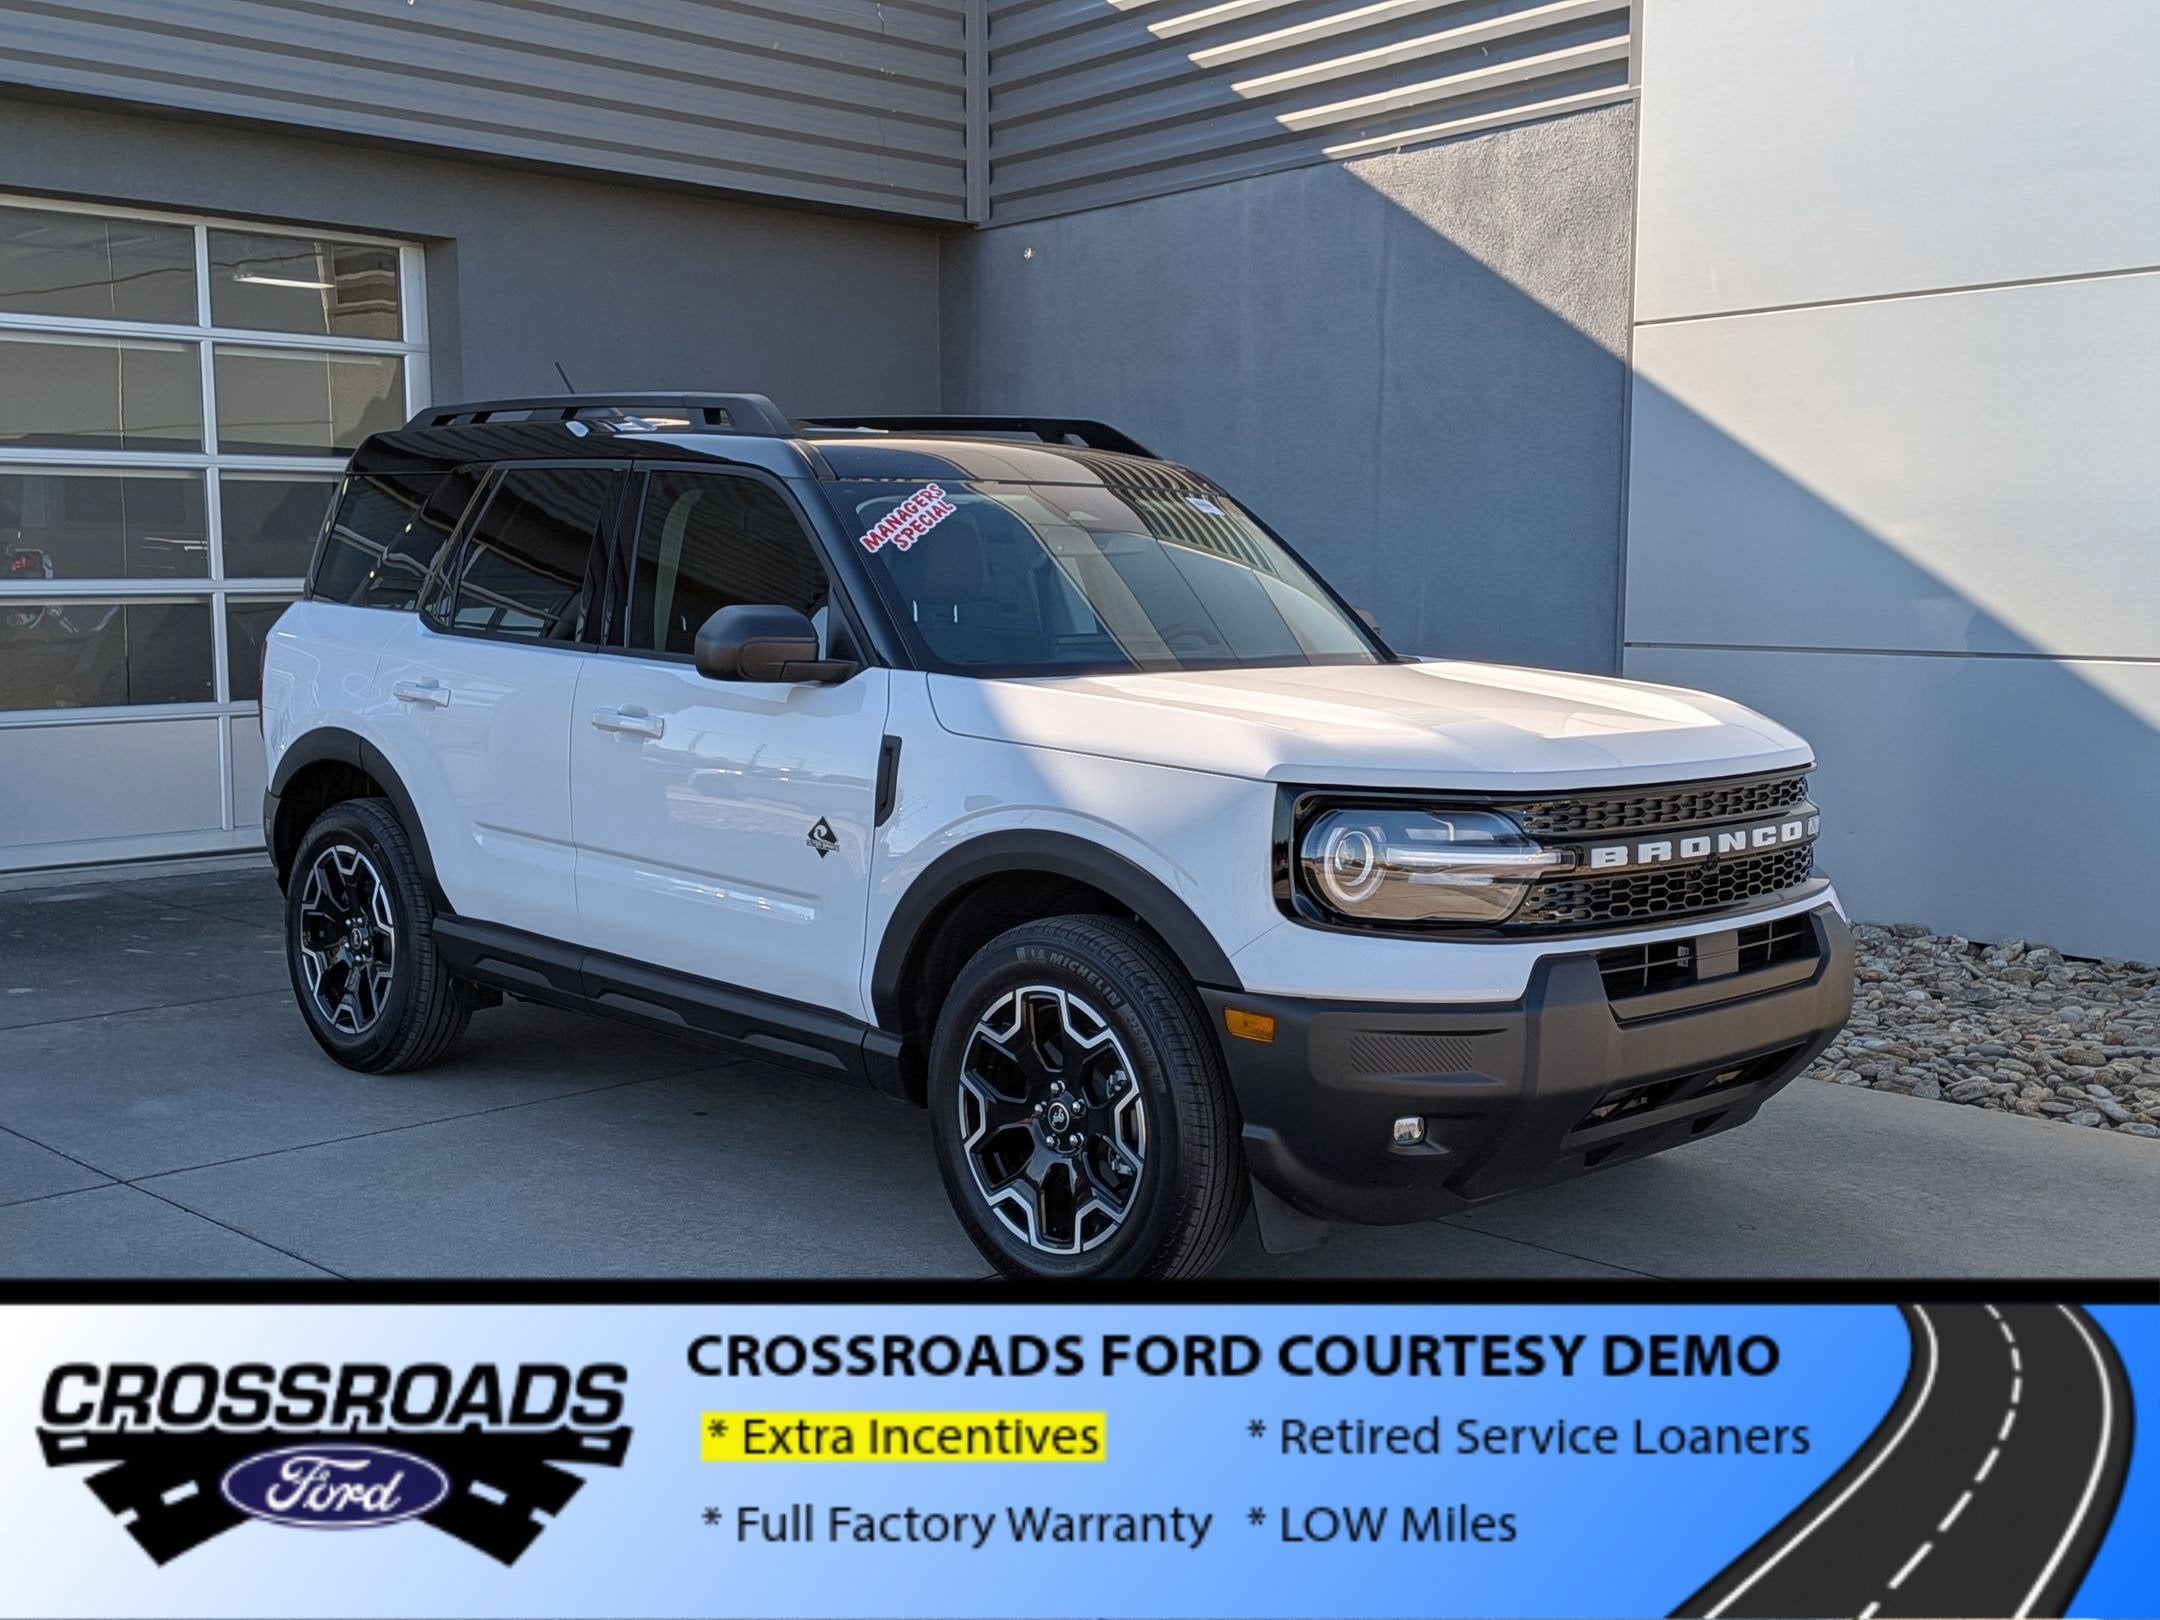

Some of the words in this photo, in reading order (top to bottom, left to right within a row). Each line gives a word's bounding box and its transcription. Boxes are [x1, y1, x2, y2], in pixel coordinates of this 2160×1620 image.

[861, 484, 944, 552] MANAGERS
[893, 501, 955, 550] SPECIAL
[1590, 820, 1803, 869] BRONCO
[1049, 952, 1123, 1007] MICHELIN
